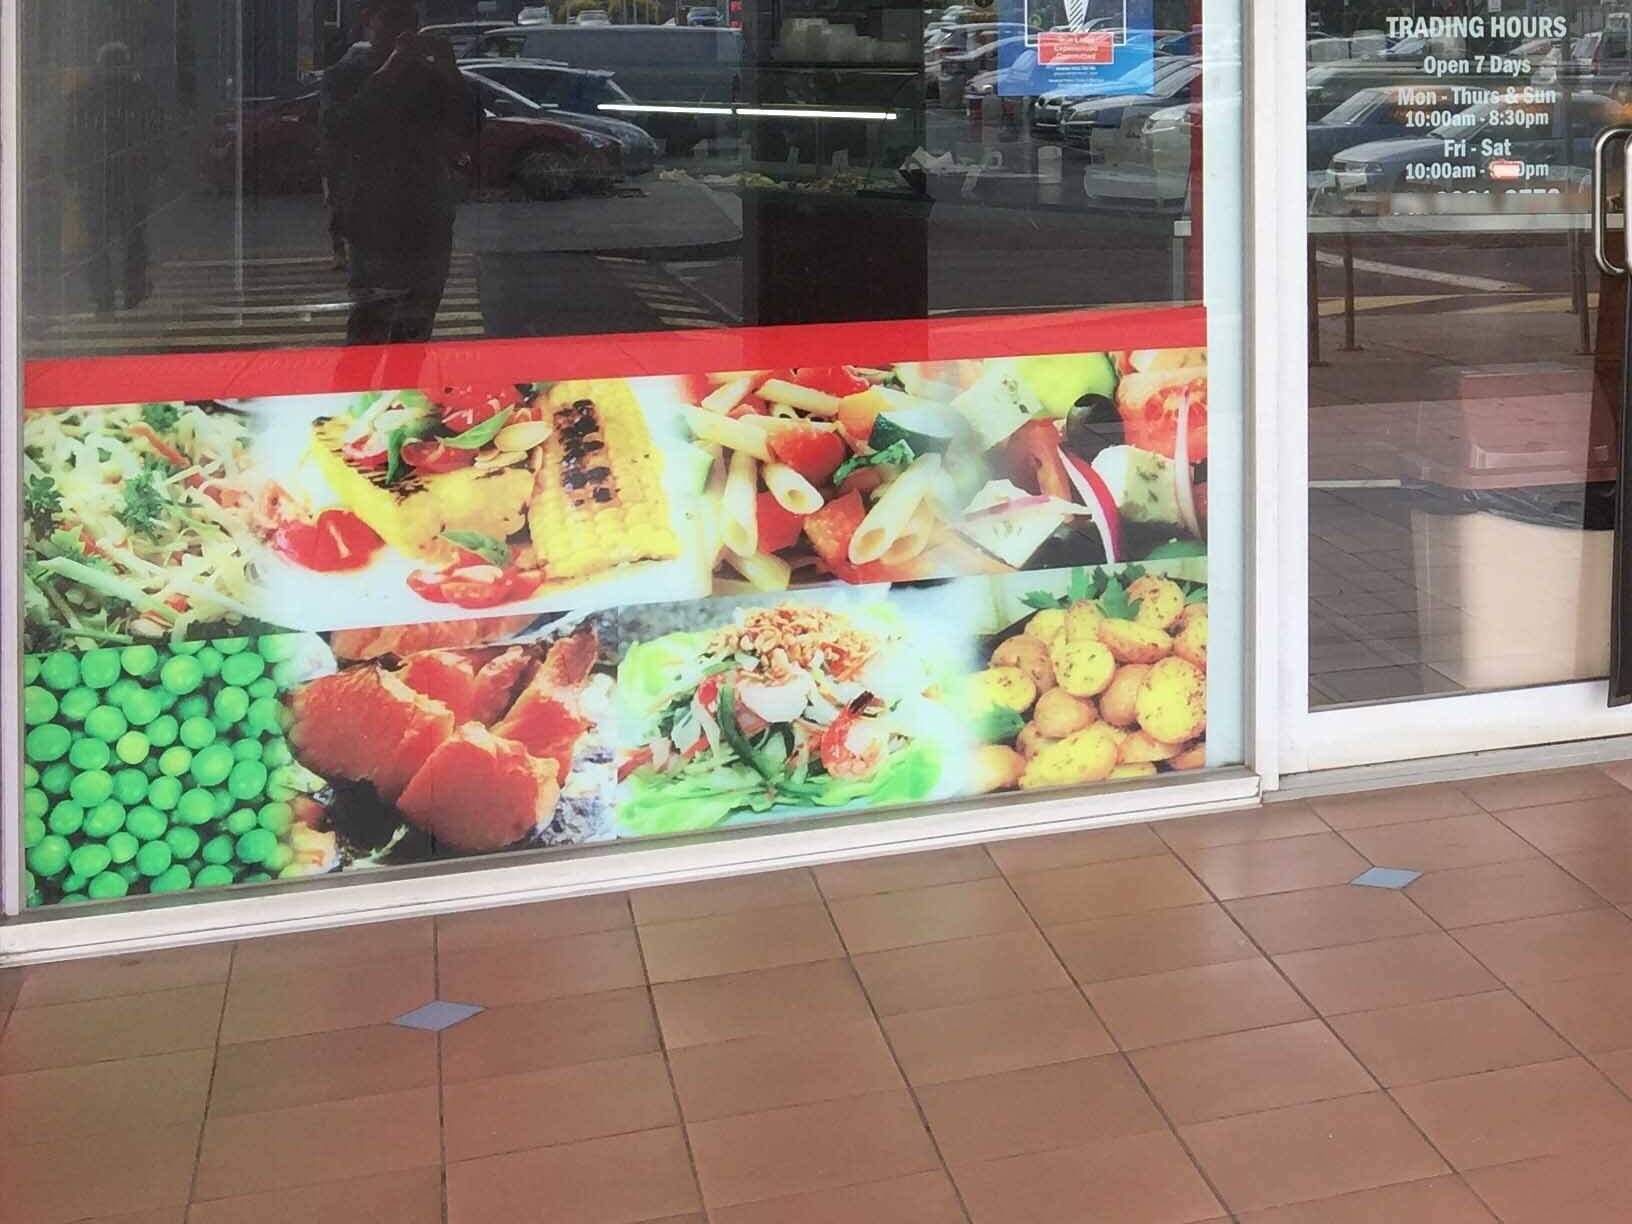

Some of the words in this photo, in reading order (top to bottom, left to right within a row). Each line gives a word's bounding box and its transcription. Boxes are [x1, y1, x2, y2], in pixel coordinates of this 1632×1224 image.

[1386, 16, 1484, 38] TRADING
[1491, 16, 1567, 38] HOURS
[1423, 56, 1470, 77] Open
[1474, 56, 1485, 73] 7
[1490, 56, 1531, 77] Days
[1397, 88, 1436, 105] Mon
[1451, 87, 1500, 105] Thurs
[1504, 86, 1519, 104] &
[1522, 86, 1556, 104] Sun
[1405, 110, 1476, 127] 10:00am
[1489, 110, 1549, 128] 8:30pm
[1443, 139, 1466, 157] Fri
[1481, 138, 1511, 156] Sat
[1405, 163, 1476, 180] 10:00am
